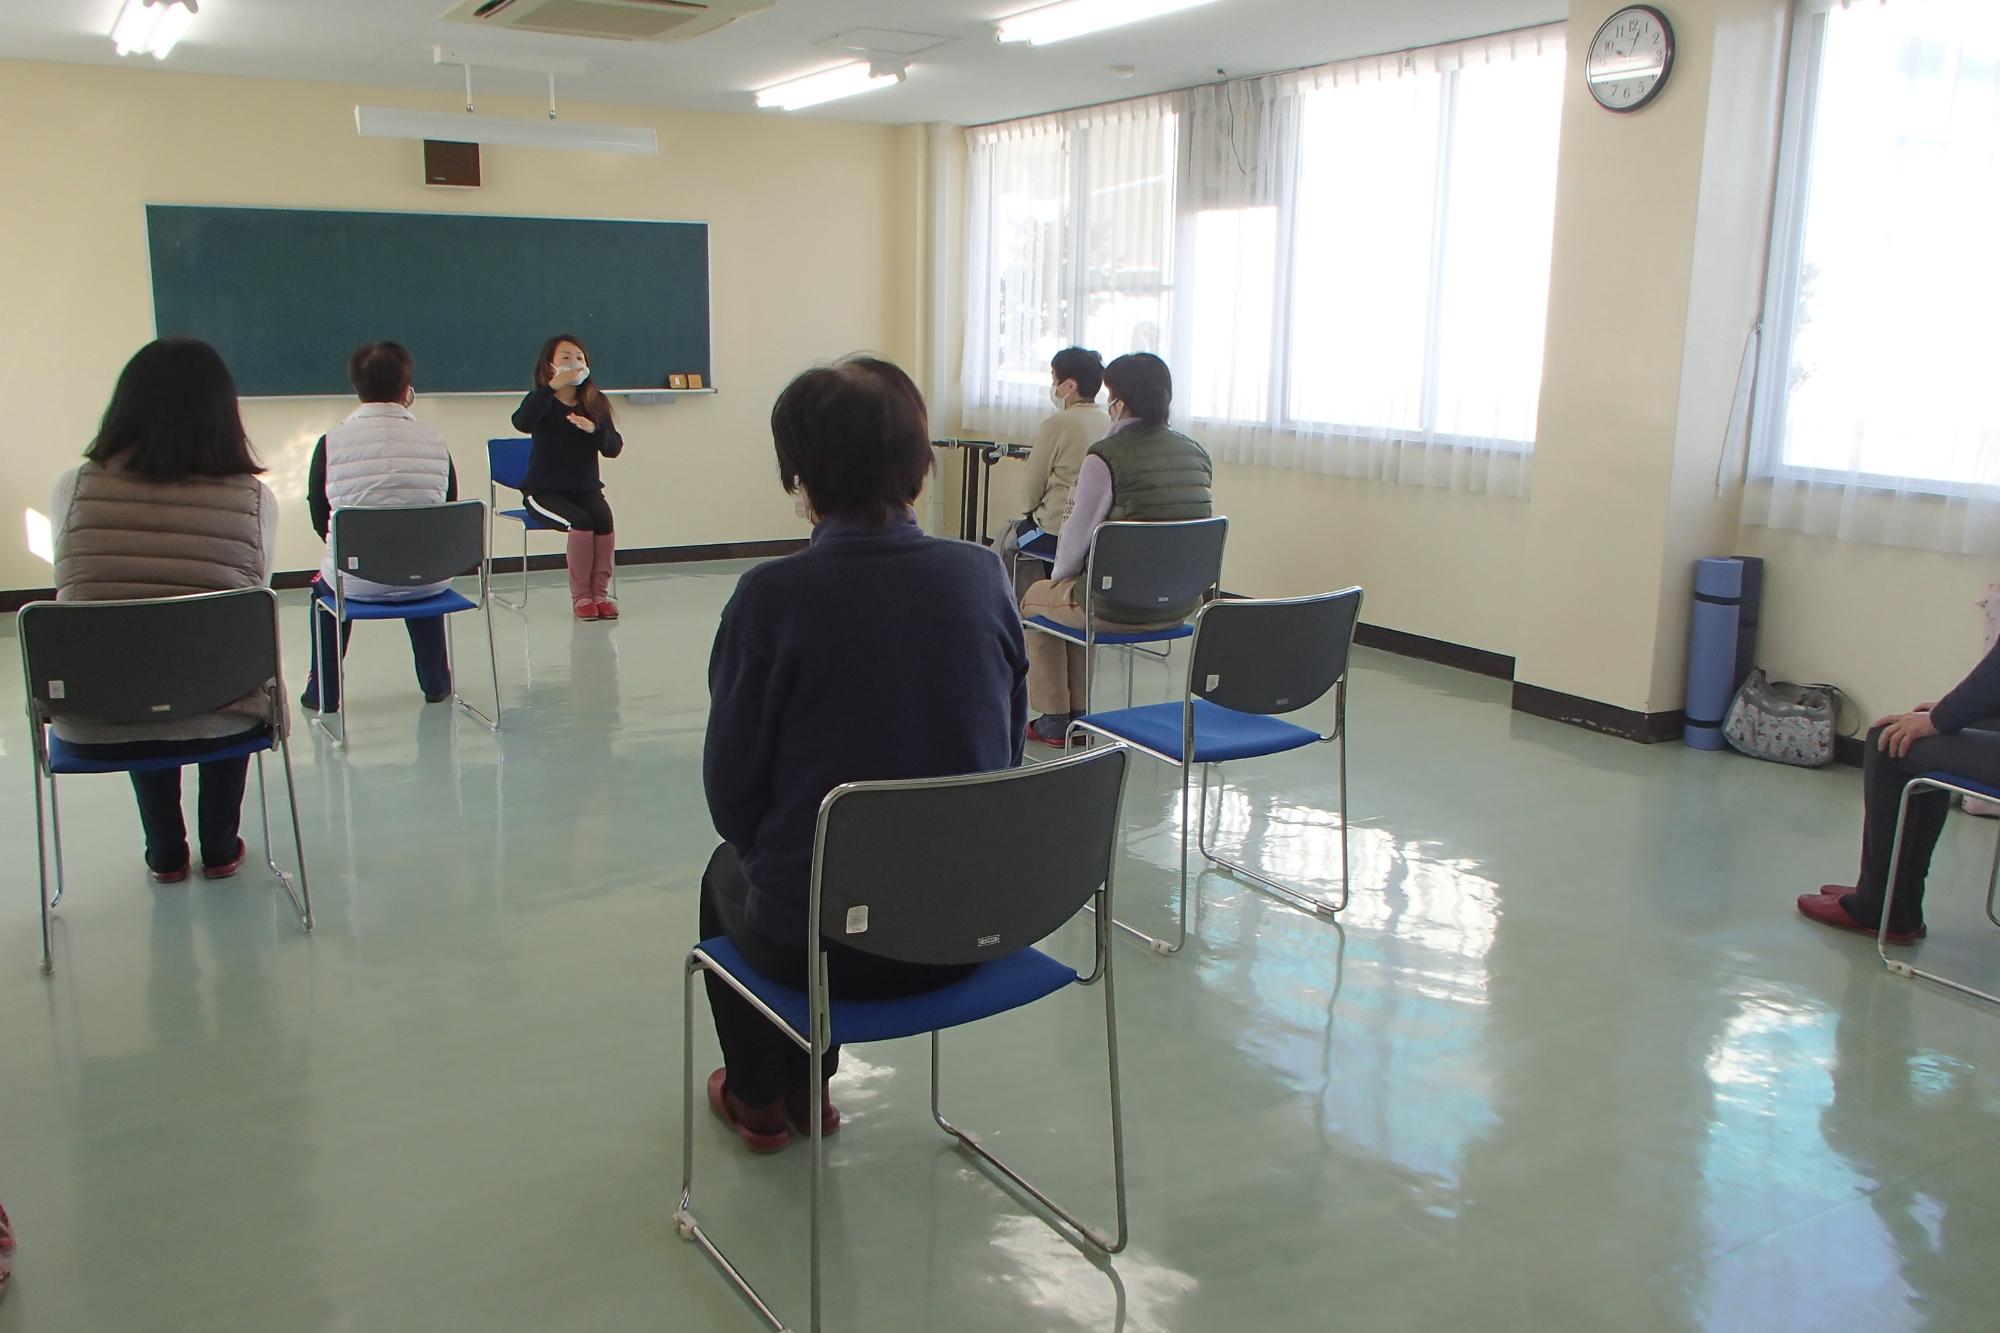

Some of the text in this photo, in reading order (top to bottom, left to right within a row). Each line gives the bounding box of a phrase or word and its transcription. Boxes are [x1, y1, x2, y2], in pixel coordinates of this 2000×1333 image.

[1628, 18, 1638, 32] 12
[1644, 22, 1649, 33] 1
[1616, 25, 1624, 38] 11
[1652, 32, 1661, 45] 2
[1604, 40, 1614, 52] 10
[1655, 49, 1663, 62] 3
[1611, 85, 1618, 97] 7
[1623, 88, 1630, 99] 6
[1637, 82, 1645, 93] 5
